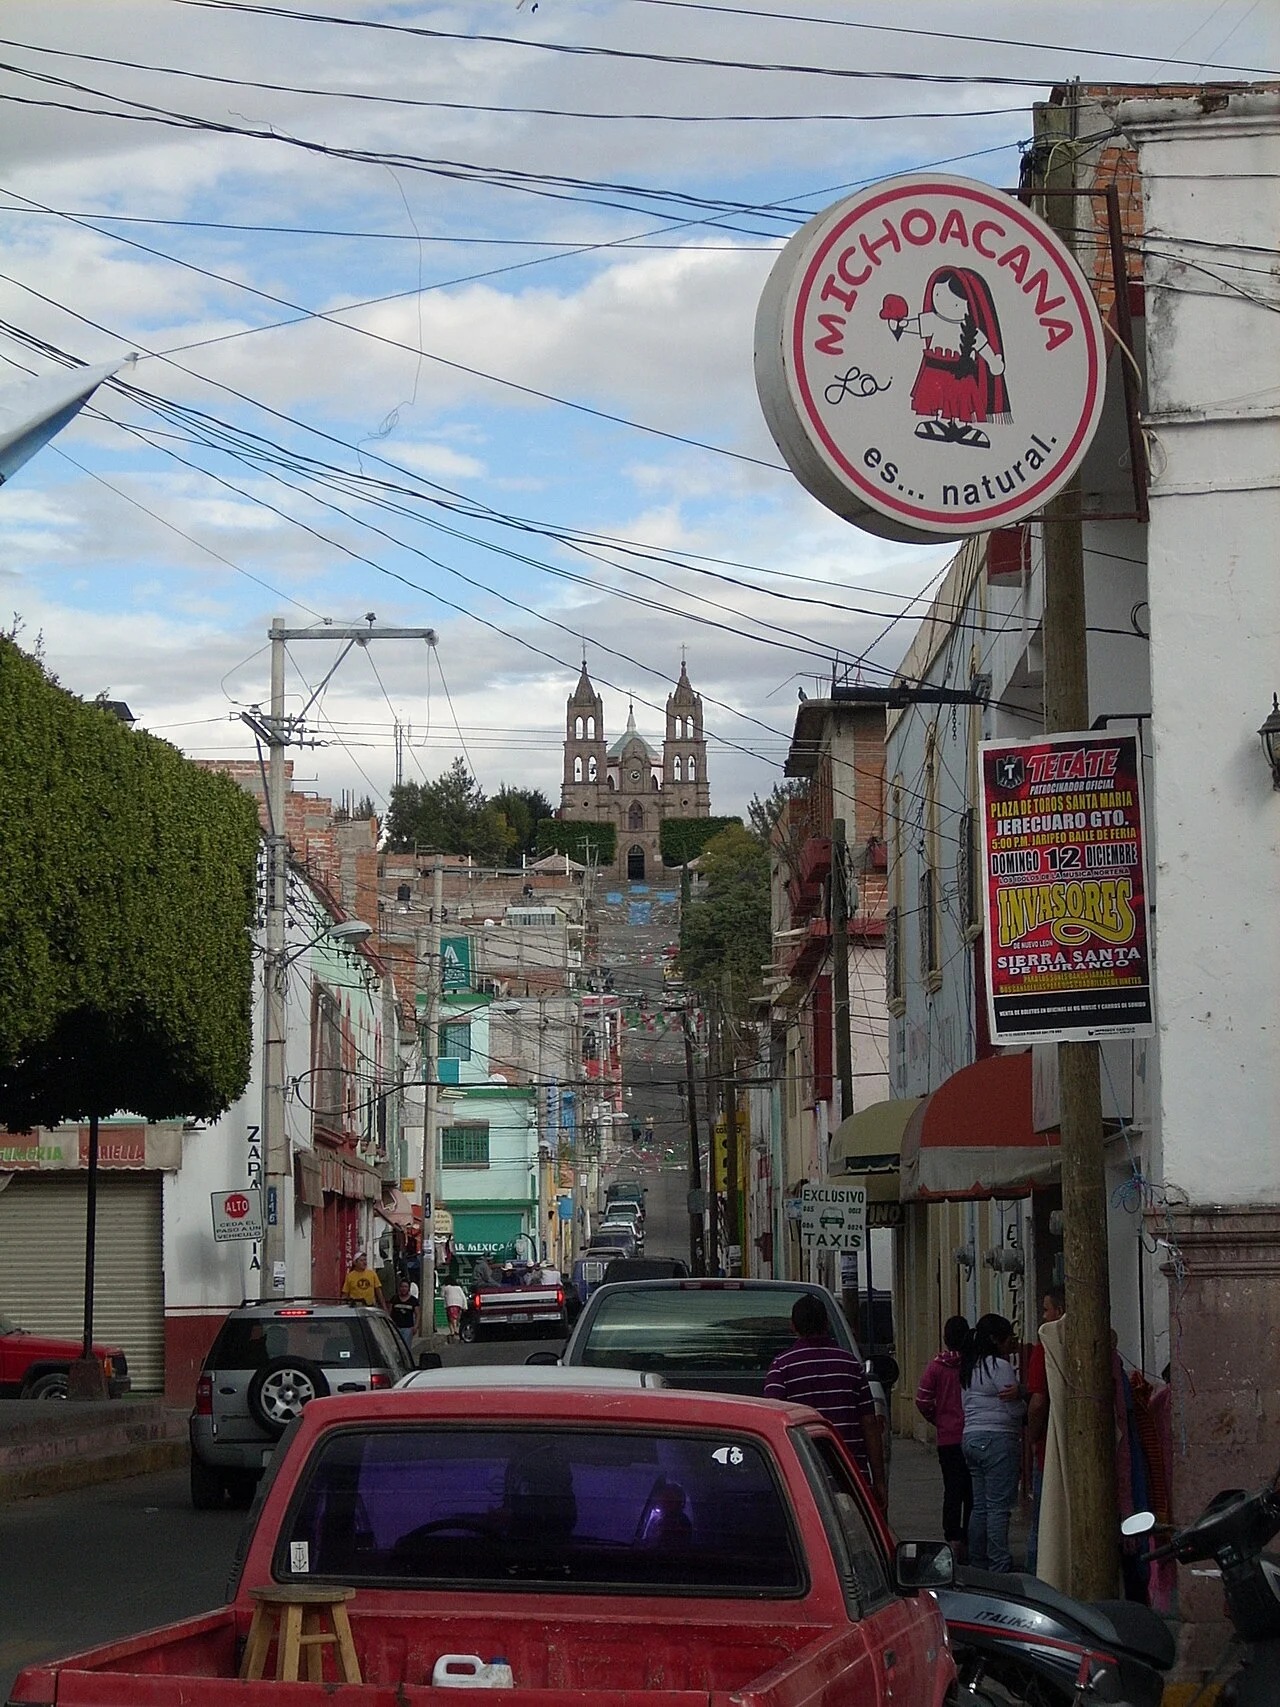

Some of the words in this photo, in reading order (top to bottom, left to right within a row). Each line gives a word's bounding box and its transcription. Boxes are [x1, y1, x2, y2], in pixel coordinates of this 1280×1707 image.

[815, 208, 1073, 355] MICHOACANA
[825, 366, 893, 404] La
[863, 447, 925, 499] es...
[943, 434, 1057, 505] natural.
[1026, 747, 1121, 782] TECATE
[1029, 781, 1084, 796] PATROCINADOR
[1085, 778, 1114, 791] OFICIAL
[990, 801, 1019, 818] PLAZA
[1020, 799, 1032, 815] DE
[1033, 796, 1064, 813] TOROS
[1065, 793, 1098, 811] SANTA
[1100, 790, 1133, 808] MARIA
[996, 812, 1086, 836] JERECUARO
[1090, 809, 1129, 828] GTO.
[991, 837, 1012, 850] 5:00
[1014, 835, 1031, 848] P.M.
[1031, 832, 1067, 846] JARIPEO
[1068, 829, 1095, 843] BAILE
[1096, 828, 1109, 840] DE
[1110, 827, 1137, 840] FERIA
[991, 849, 1041, 876] DOMINGO
[1043, 845, 1081, 871] 12
[1085, 842, 1138, 868] DICIEMBRE
[999, 876, 1013, 886] LOS
[1014, 873, 1040, 884] IDOLOS
[1041, 872, 1050, 881] DE
[1051, 871, 1062, 880] LA
[1062, 869, 1093, 879] MUSICA
[1093, 867, 1130, 877] NORTEÑA
[997, 877, 1135, 947] INVASORES
[1021, 941, 1039, 949] NUEVO
[997, 951, 1066, 968] SIERRA
[1072, 947, 1141, 963] SANTA
[1009, 966, 1031, 975] DE
[1037, 959, 1130, 973] DURANGO
[226, 1200, 249, 1212] ALTO
[247, 1126, 261, 1270] ZAPAIA
[803, 1189, 864, 1203] EXCLUSIVO
[217, 1231, 261, 1239] VEHICULO
[803, 1232, 862, 1248] TAXIS
[974, 1610, 1034, 1629] ITALIKA
